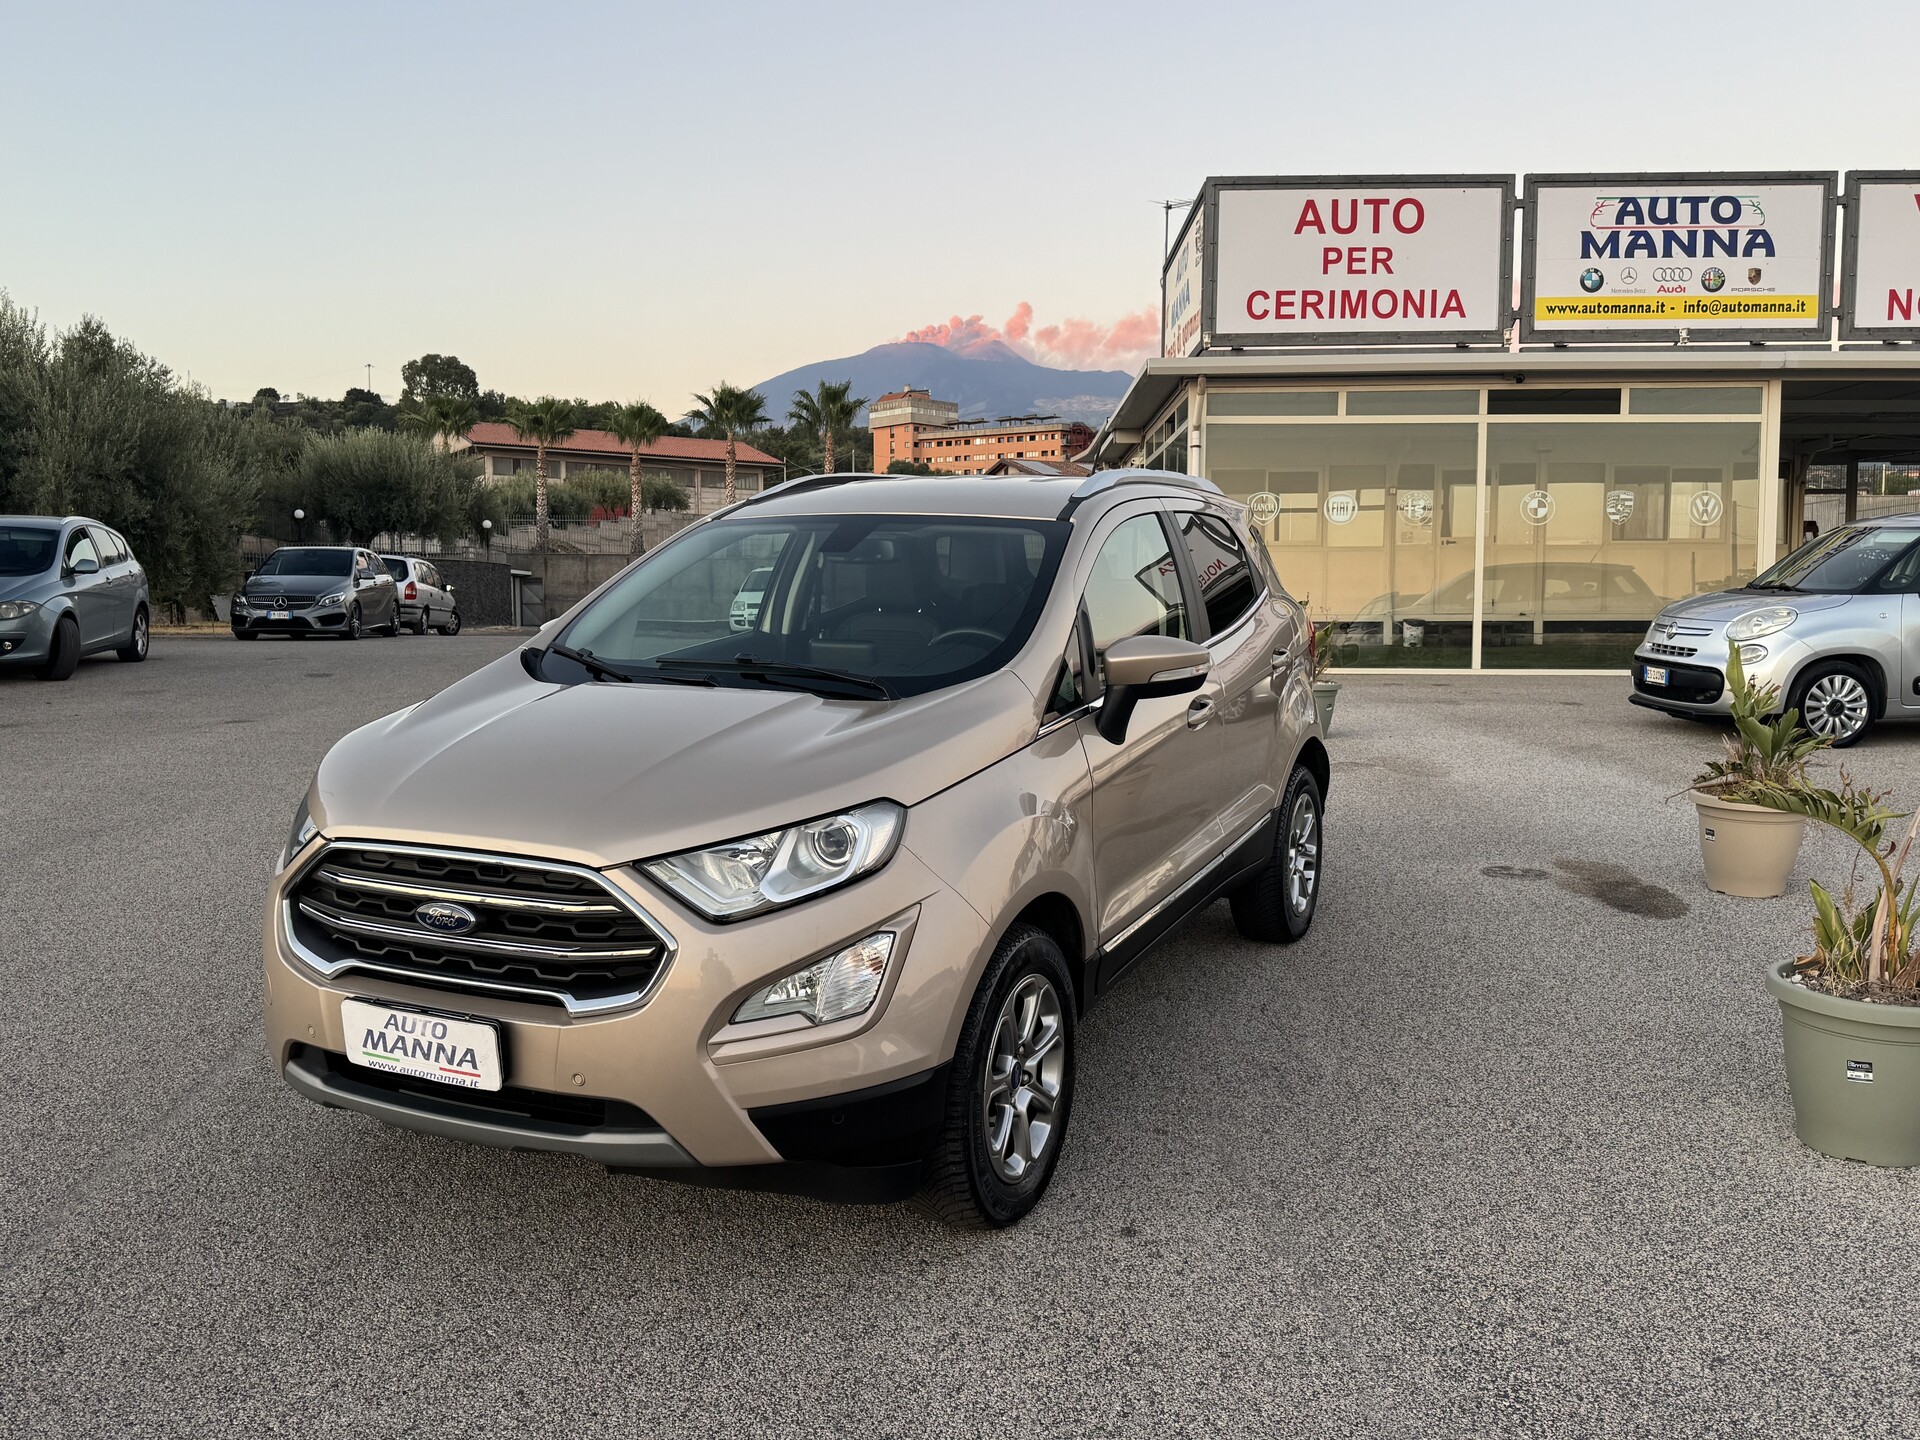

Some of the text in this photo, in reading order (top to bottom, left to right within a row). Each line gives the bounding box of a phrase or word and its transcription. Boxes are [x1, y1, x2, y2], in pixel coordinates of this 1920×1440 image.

[1294, 198, 1425, 235] AUTO
[1614, 195, 1742, 225] AUTO
[1580, 229, 1776, 259] MANNA
[1322, 247, 1394, 275] PER
[1657, 285, 1686, 294] Audi
[1246, 289, 1467, 320] CERIMONIA
[1546, 301, 1666, 314] www.automanna.it
[1683, 300, 1806, 315] info@automanna.it
[1253, 502, 1275, 512] LANCIA
[1331, 501, 1350, 516] FIAT
[426, 907, 458, 927] Ford
[384, 1013, 448, 1040] AUTO
[362, 1028, 479, 1070] MANNA
[368, 1060, 480, 1088] www.automanna.it
